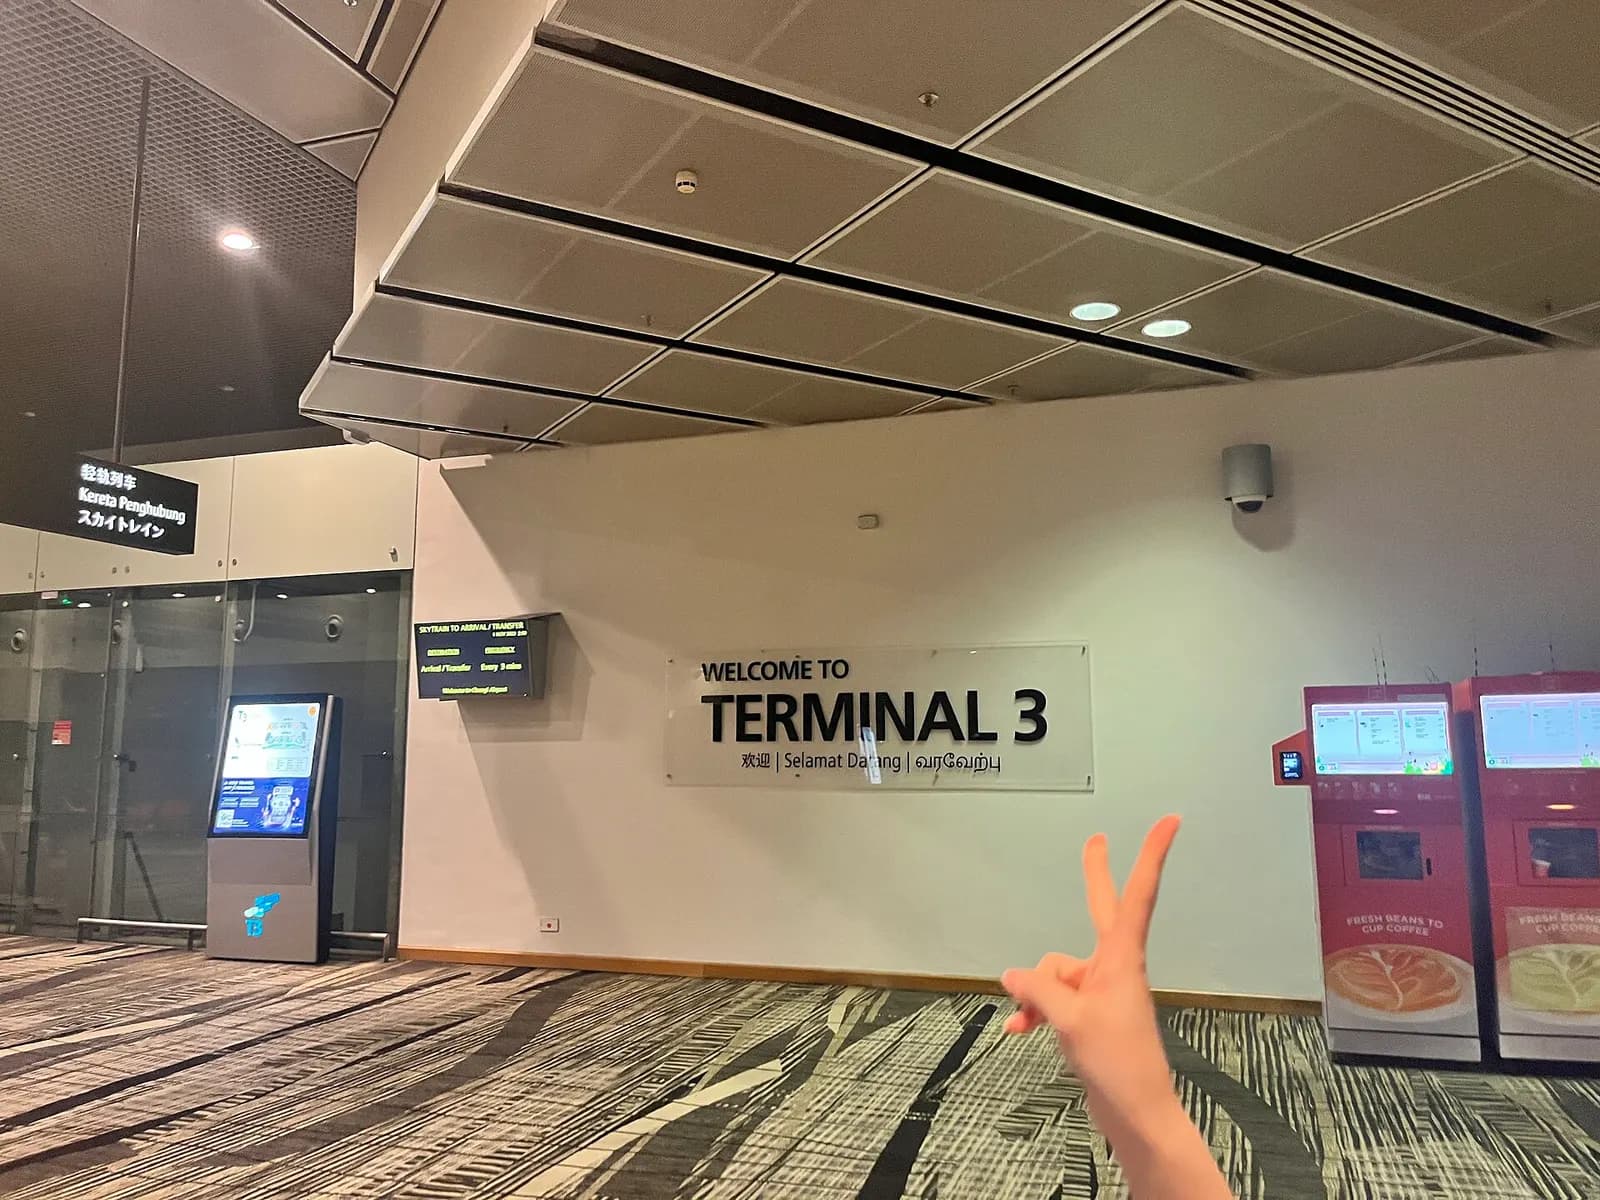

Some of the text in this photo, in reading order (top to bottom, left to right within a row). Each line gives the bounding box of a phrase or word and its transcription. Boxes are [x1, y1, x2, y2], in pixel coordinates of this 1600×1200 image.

[78, 486, 186, 525] Kereta Penghubung
[77, 509, 165, 538] スカイトレイン
[450, 624, 460, 632] TO
[701, 659, 850, 682] WELCOME TO
[701, 688, 1048, 743] TERMINAL 3
[741, 752, 771, 769] 欢迎
[784, 751, 901, 773] Selamat Daang
[915, 752, 1001, 773] வரவேற்பு
[1346, 914, 1444, 929] FRESH BEANS TO
[1361, 925, 1430, 936] CUP COFFEE
